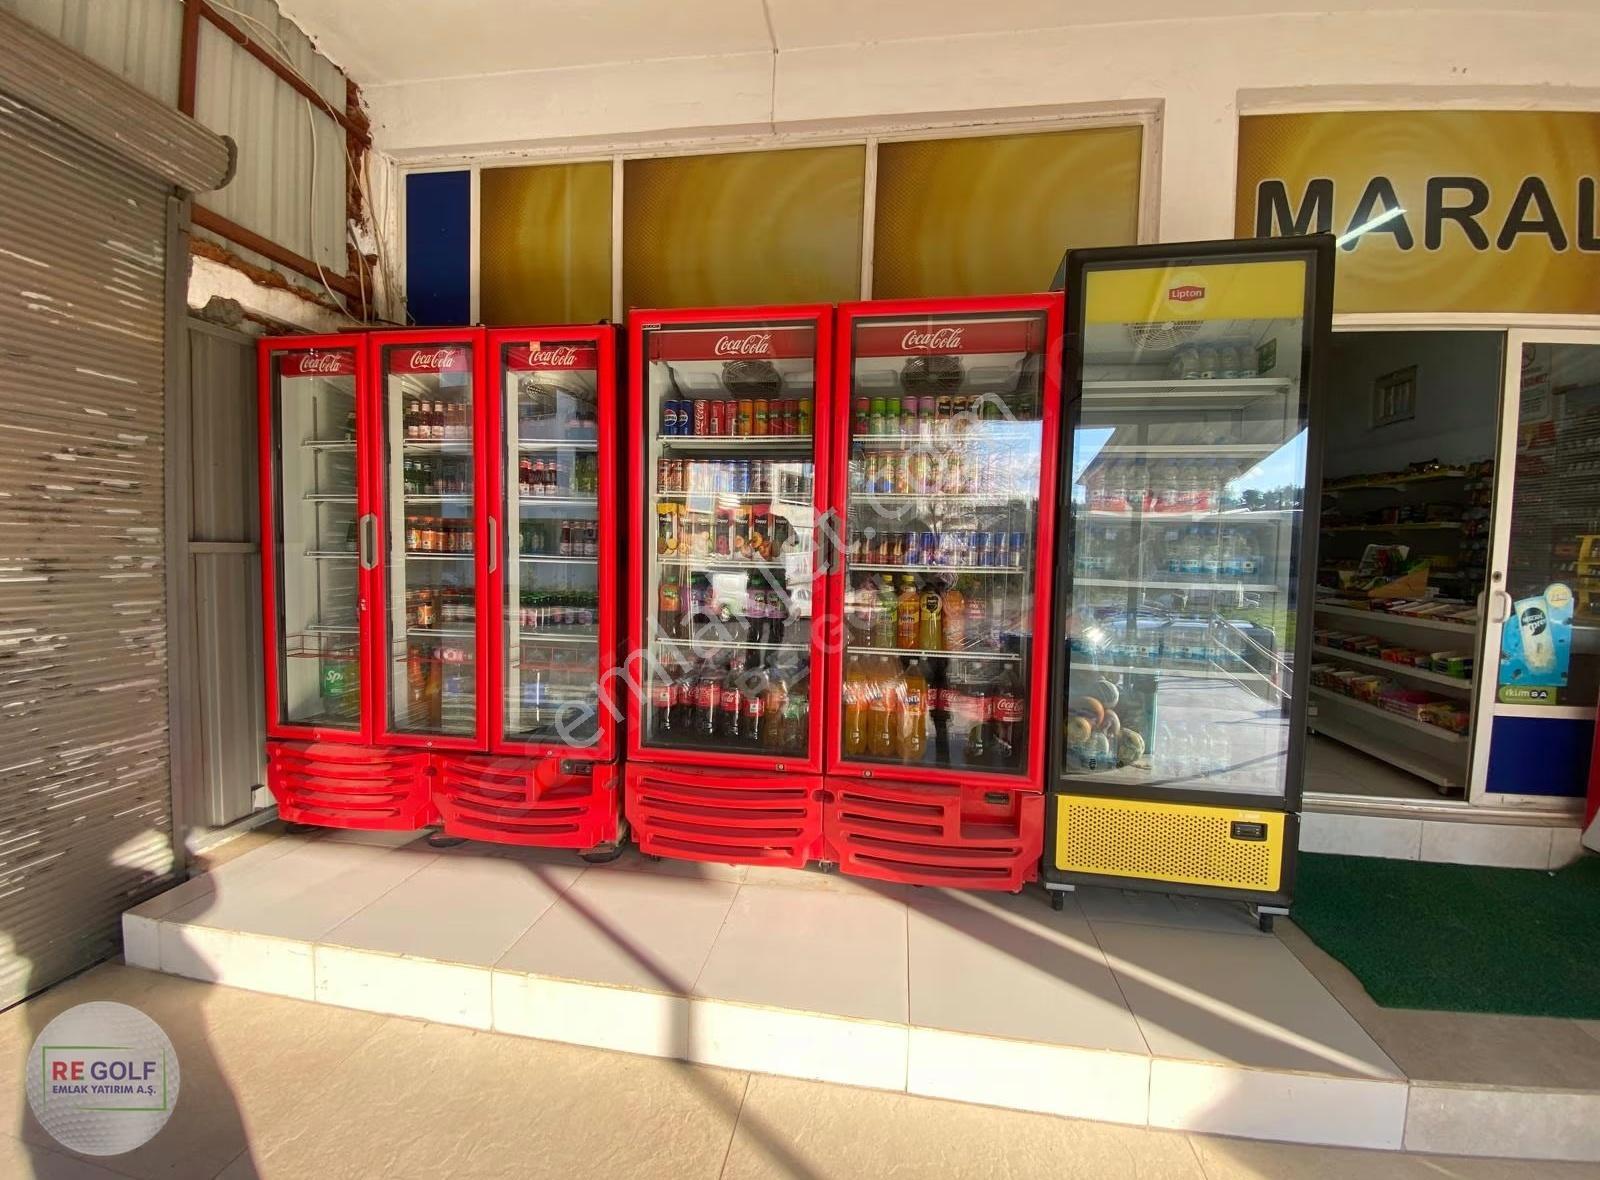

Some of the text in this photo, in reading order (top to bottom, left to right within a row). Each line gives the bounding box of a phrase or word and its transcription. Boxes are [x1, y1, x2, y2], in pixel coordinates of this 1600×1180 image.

[1255, 174, 1600, 252] MARAL
[1171, 289, 1202, 300] Lipton
[715, 334, 771, 355] Coca-Cola
[902, 328, 964, 350] Coca-Cola
[300, 354, 342, 373] Coca-Cola
[410, 350, 456, 369] Coca-Cola
[529, 346, 578, 366] Coca-Cola
